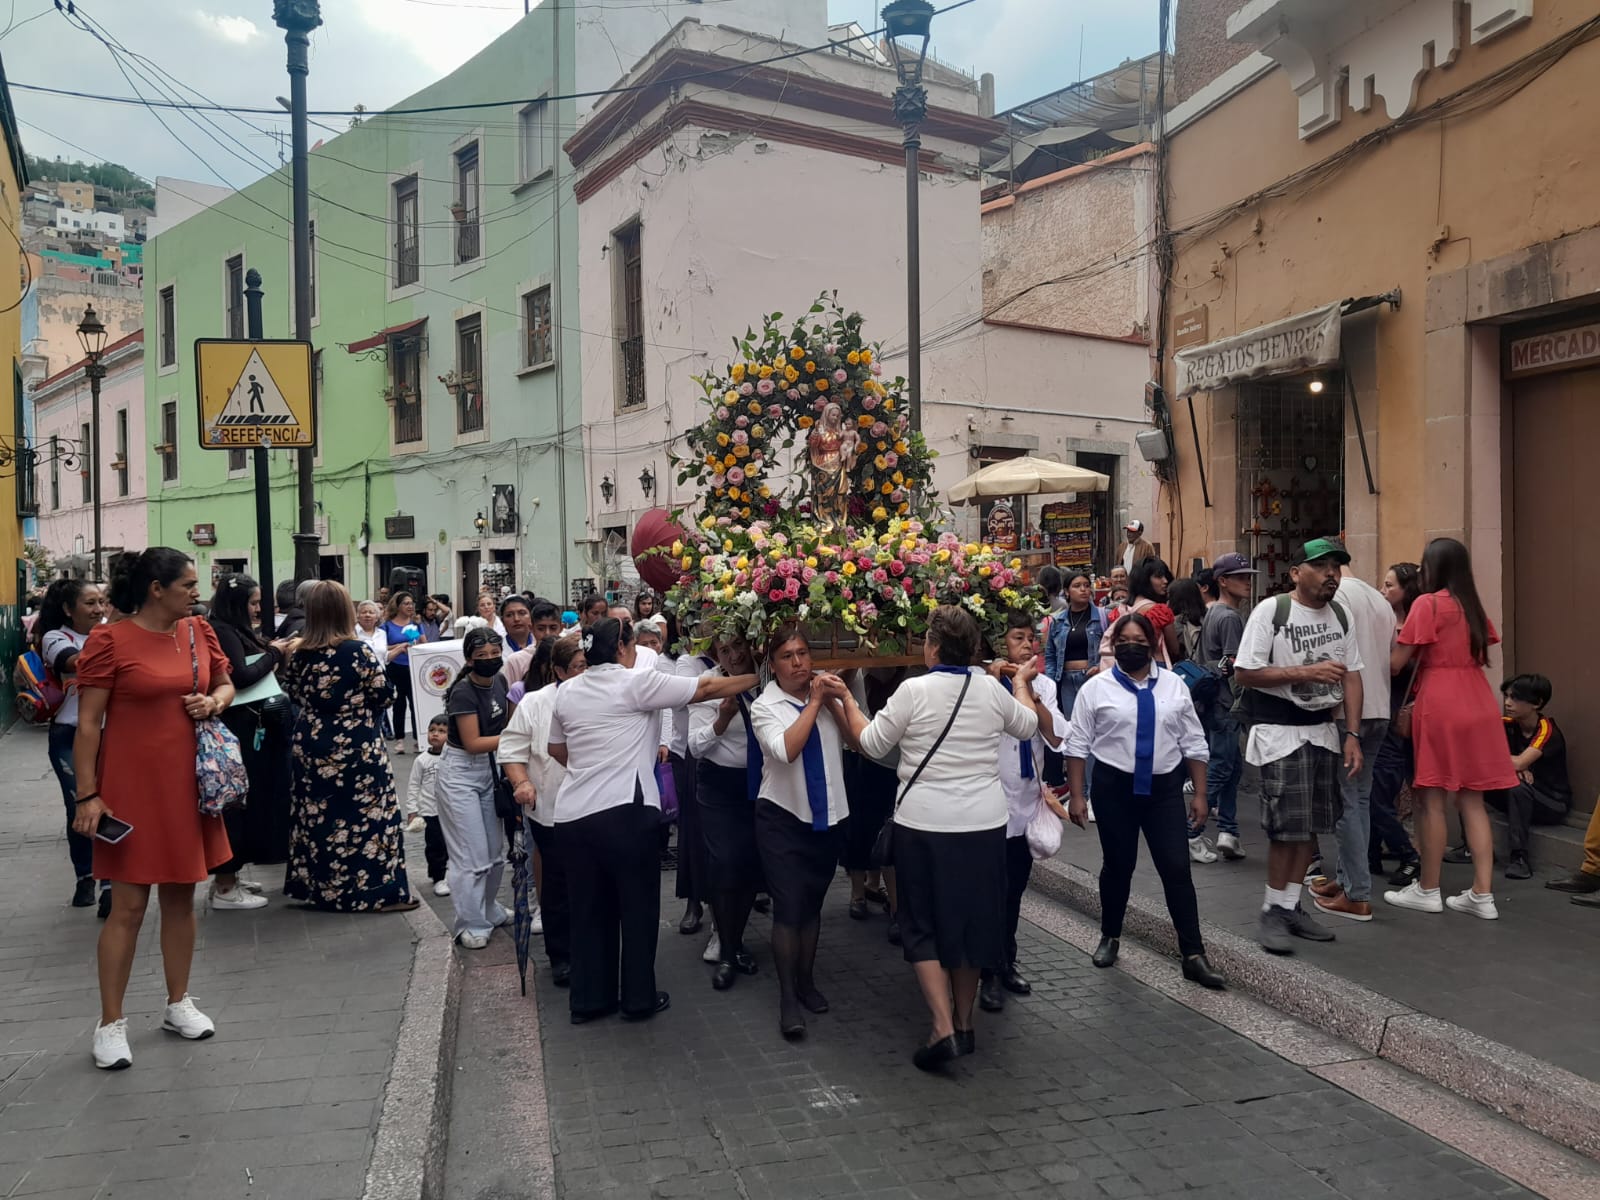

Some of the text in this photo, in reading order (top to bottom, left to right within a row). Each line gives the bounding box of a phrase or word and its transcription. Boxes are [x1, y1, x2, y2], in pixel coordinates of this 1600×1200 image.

[1187, 343, 1254, 383] REGALOS
[1513, 331, 1600, 368] MERCAD
[1291, 632, 1343, 654] DAVIDSON
